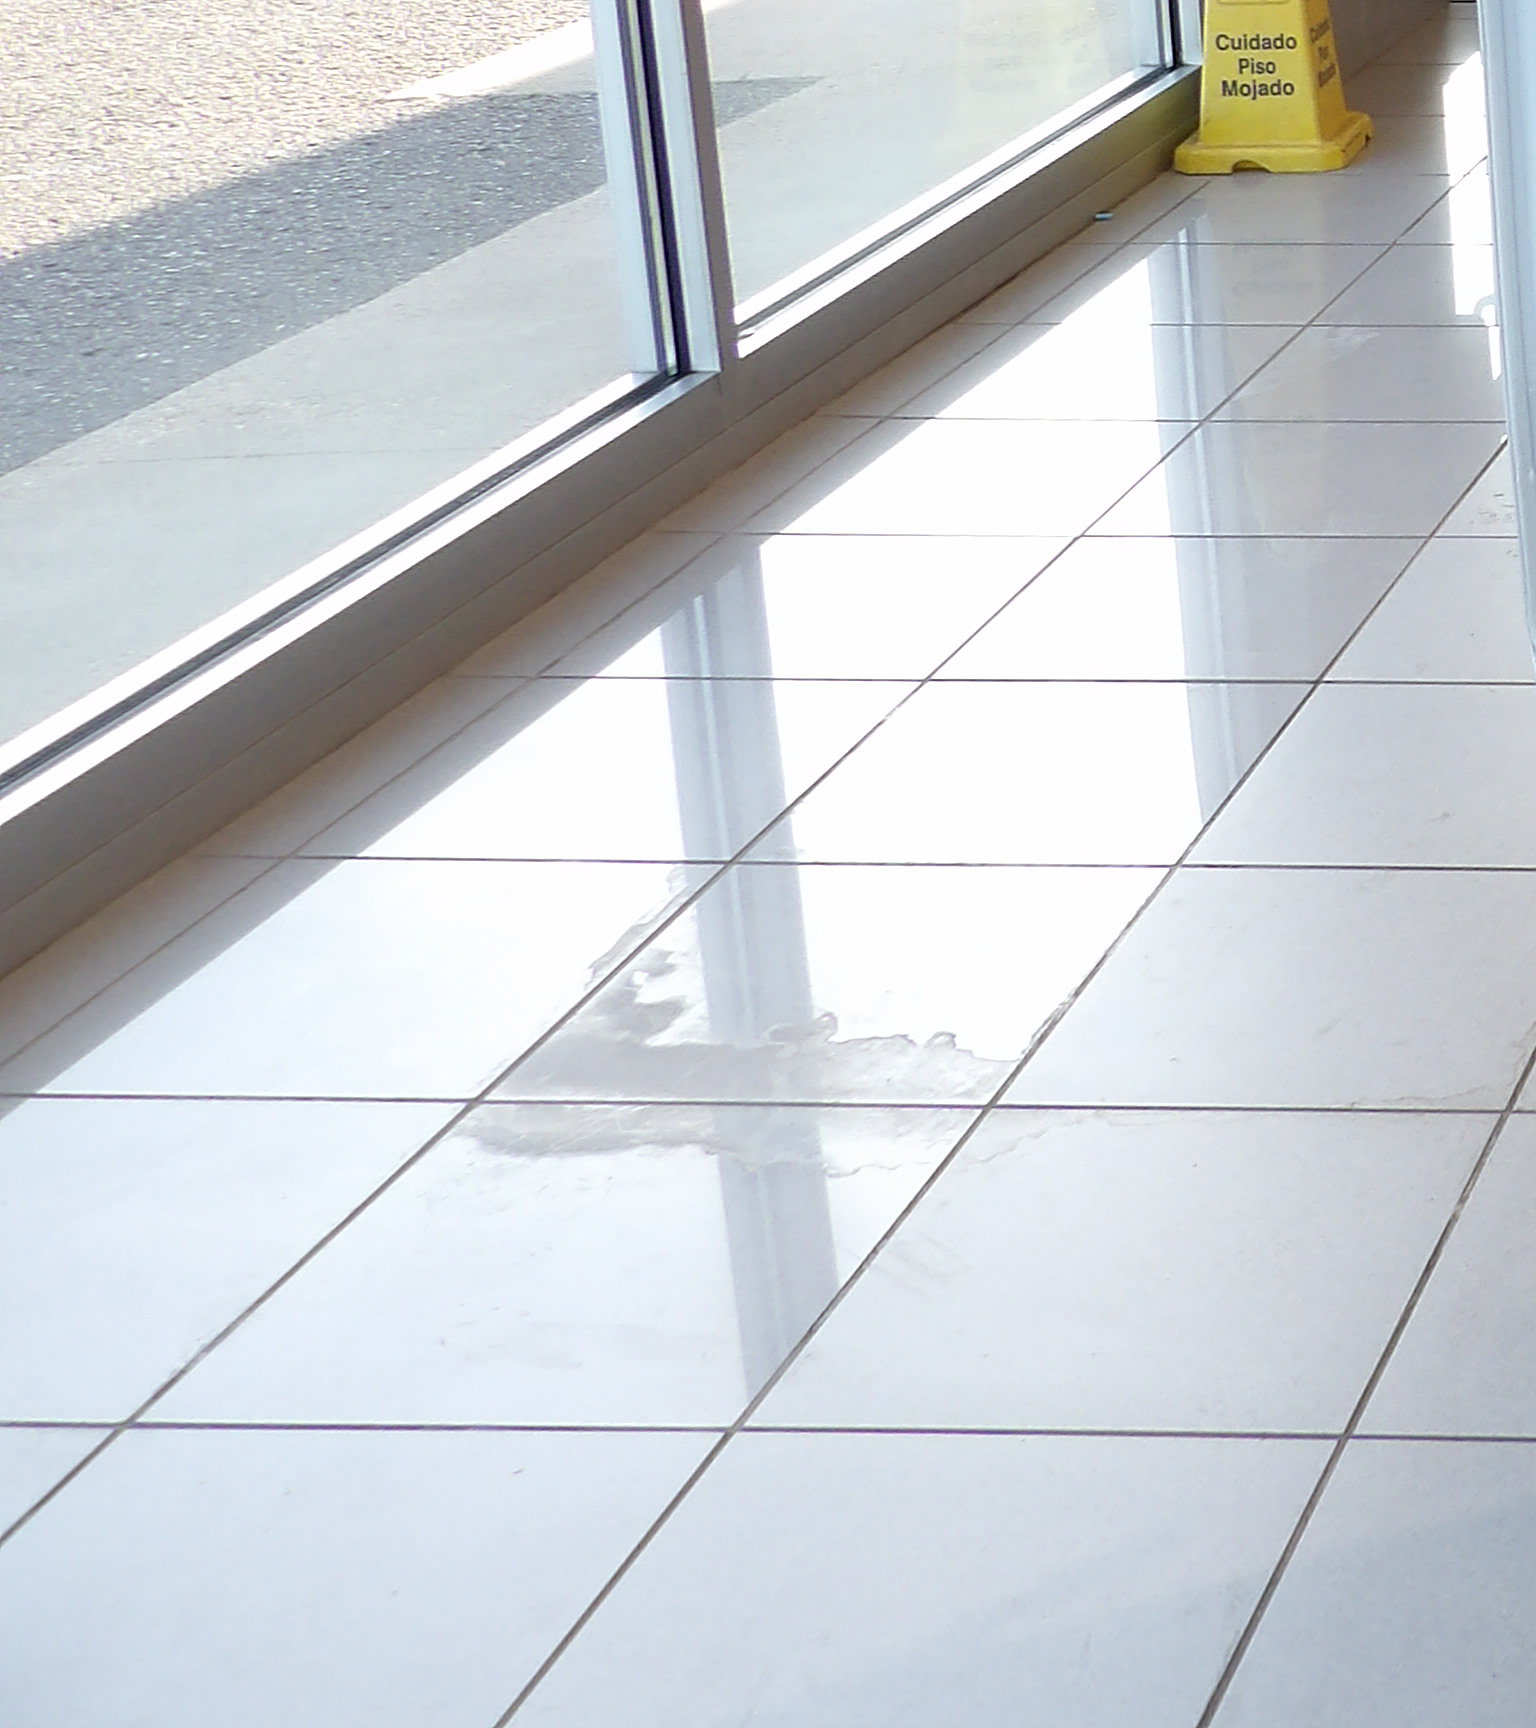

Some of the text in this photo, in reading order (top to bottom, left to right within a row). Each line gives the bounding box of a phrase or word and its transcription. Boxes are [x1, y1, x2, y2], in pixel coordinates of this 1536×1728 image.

[1216, 33, 1298, 51] Cuidado
[1238, 57, 1276, 75] Piso
[1221, 79, 1295, 100] Mojado
